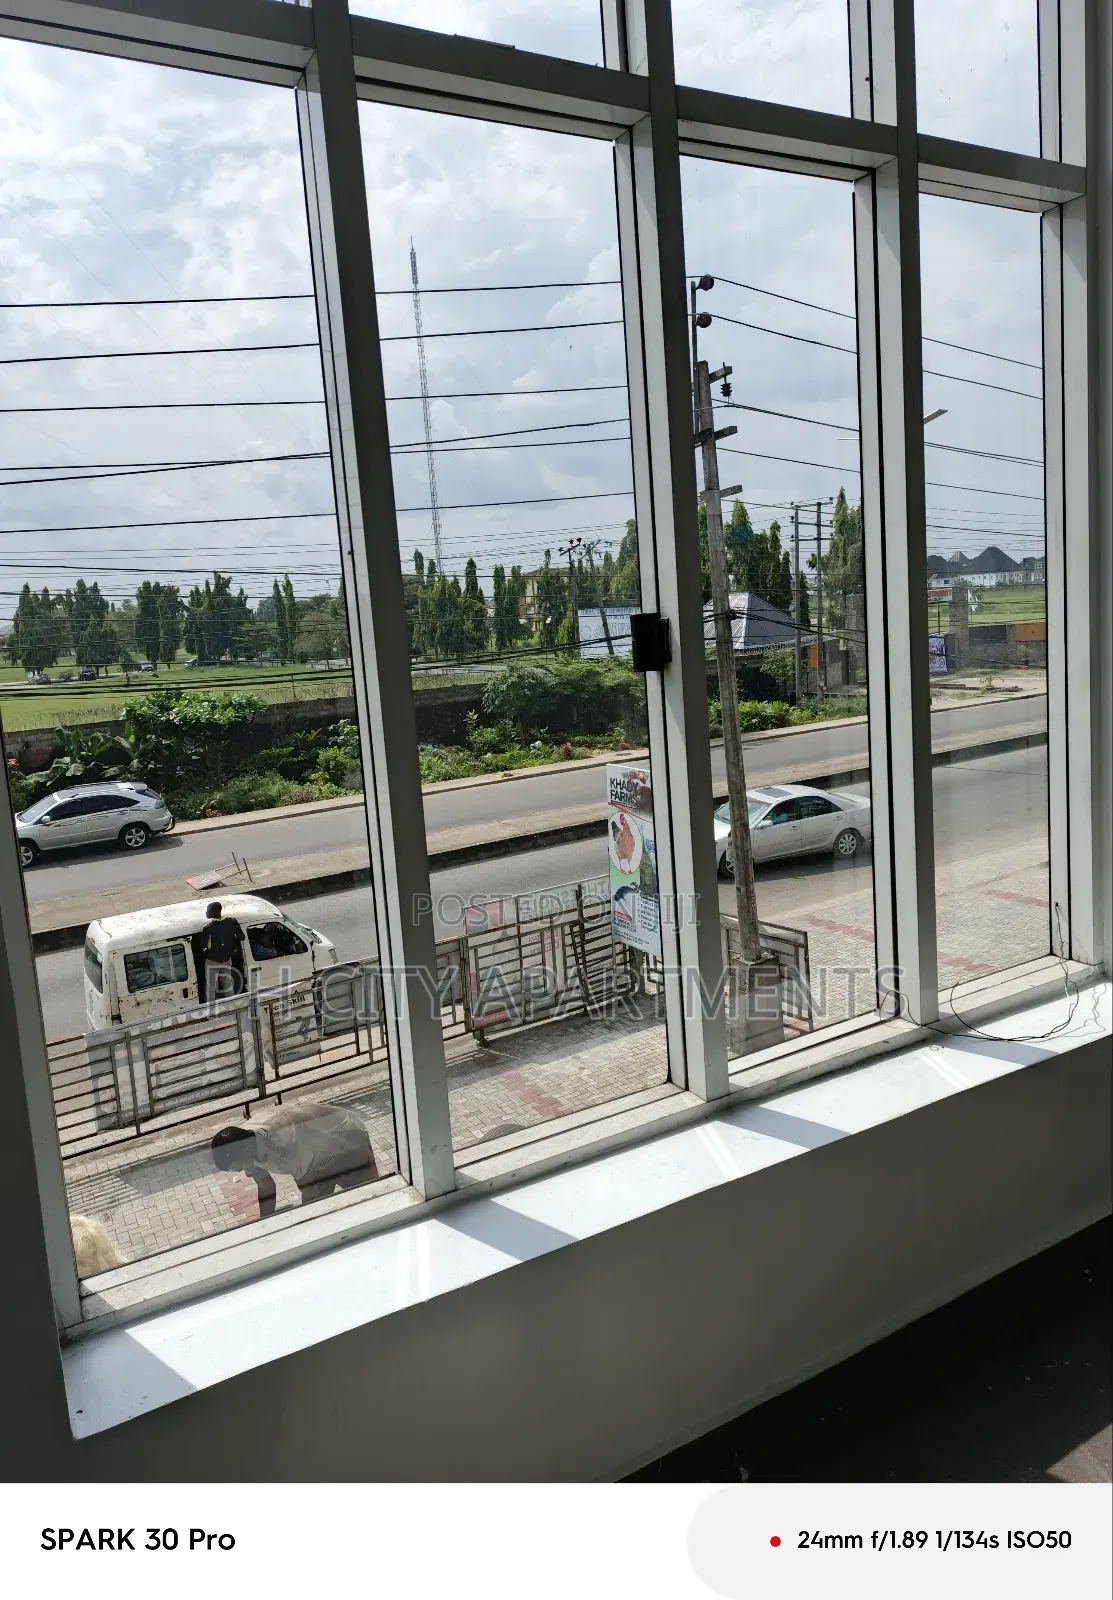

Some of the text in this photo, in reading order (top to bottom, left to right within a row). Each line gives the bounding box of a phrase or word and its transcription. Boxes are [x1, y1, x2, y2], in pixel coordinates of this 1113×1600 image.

[610, 777, 638, 793] KHADY
[610, 788, 639, 804] FARMS
[286, 995, 306, 1006] Skill
